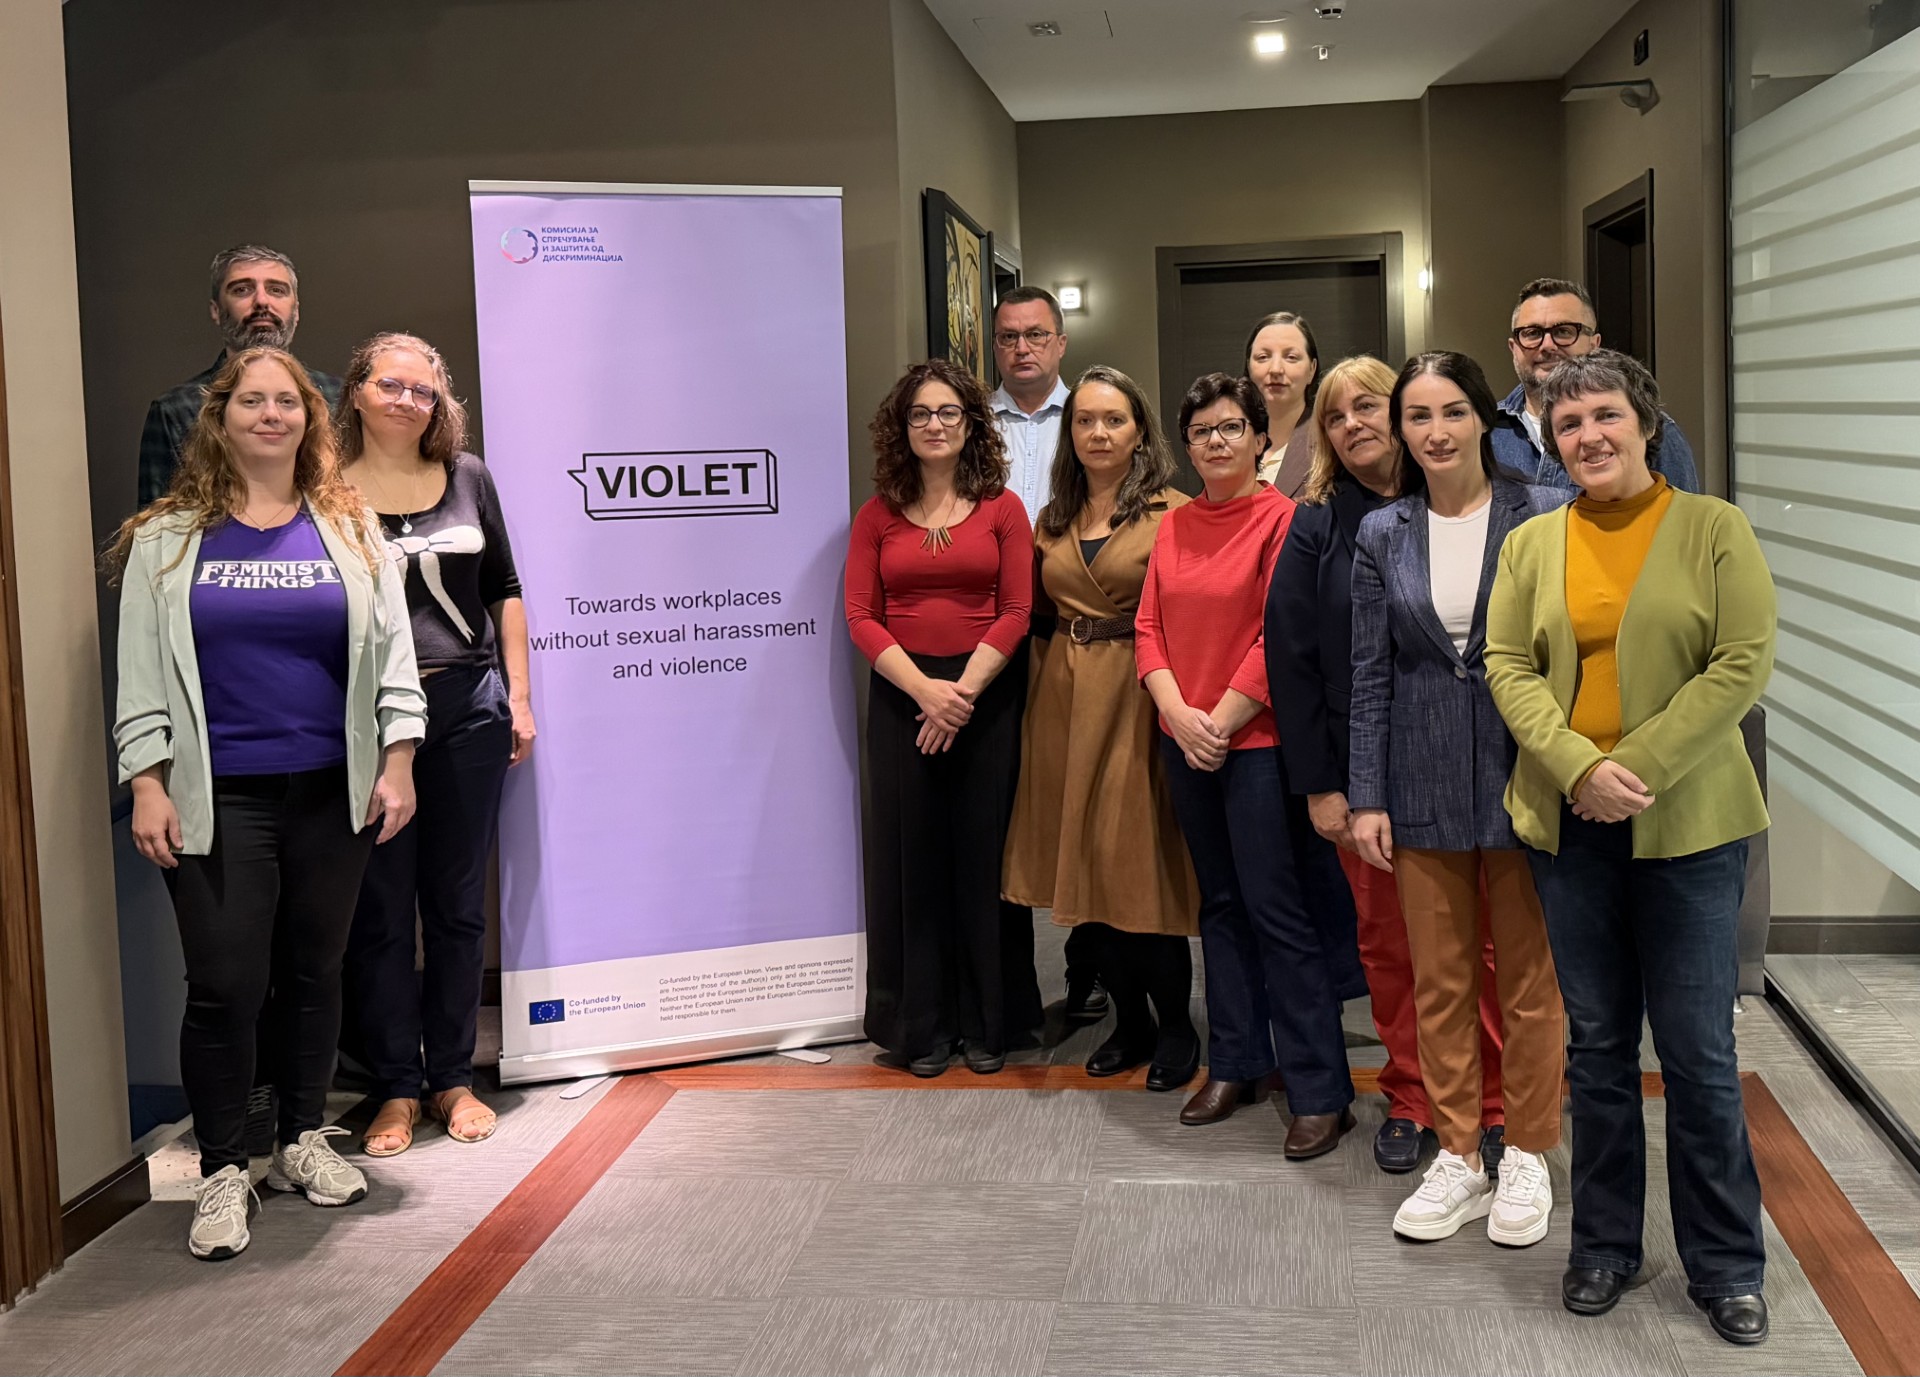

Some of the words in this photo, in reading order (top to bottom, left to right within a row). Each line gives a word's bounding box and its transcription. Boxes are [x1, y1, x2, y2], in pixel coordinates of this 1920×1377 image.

[542, 255, 623, 263] ДИСКРИМИНАЦИЈА
[596, 462, 758, 499] VIOLET
[198, 562, 336, 581] FEMINIST
[217, 576, 316, 588] THINGS
[565, 594, 656, 616] Towards
[663, 589, 782, 611] workplaces
[530, 629, 610, 651] without
[616, 624, 686, 647] sexual
[694, 618, 816, 641] harassment
[612, 659, 652, 679] and
[660, 656, 747, 676] violence
[659, 976, 691, 984] Co-funded
[824, 957, 853, 966] expressed
[821, 967, 853, 975] necessarily
[718, 988, 746, 996] European
[787, 980, 815, 988] European
[569, 995, 609, 1006] Co-funded
[695, 1000, 724, 1008] European
[767, 990, 796, 999] European
[797, 987, 833, 996] Commission
[584, 1005, 621, 1014] European
[623, 1002, 645, 1010] Union
[675, 1011, 709, 1019] responsible
